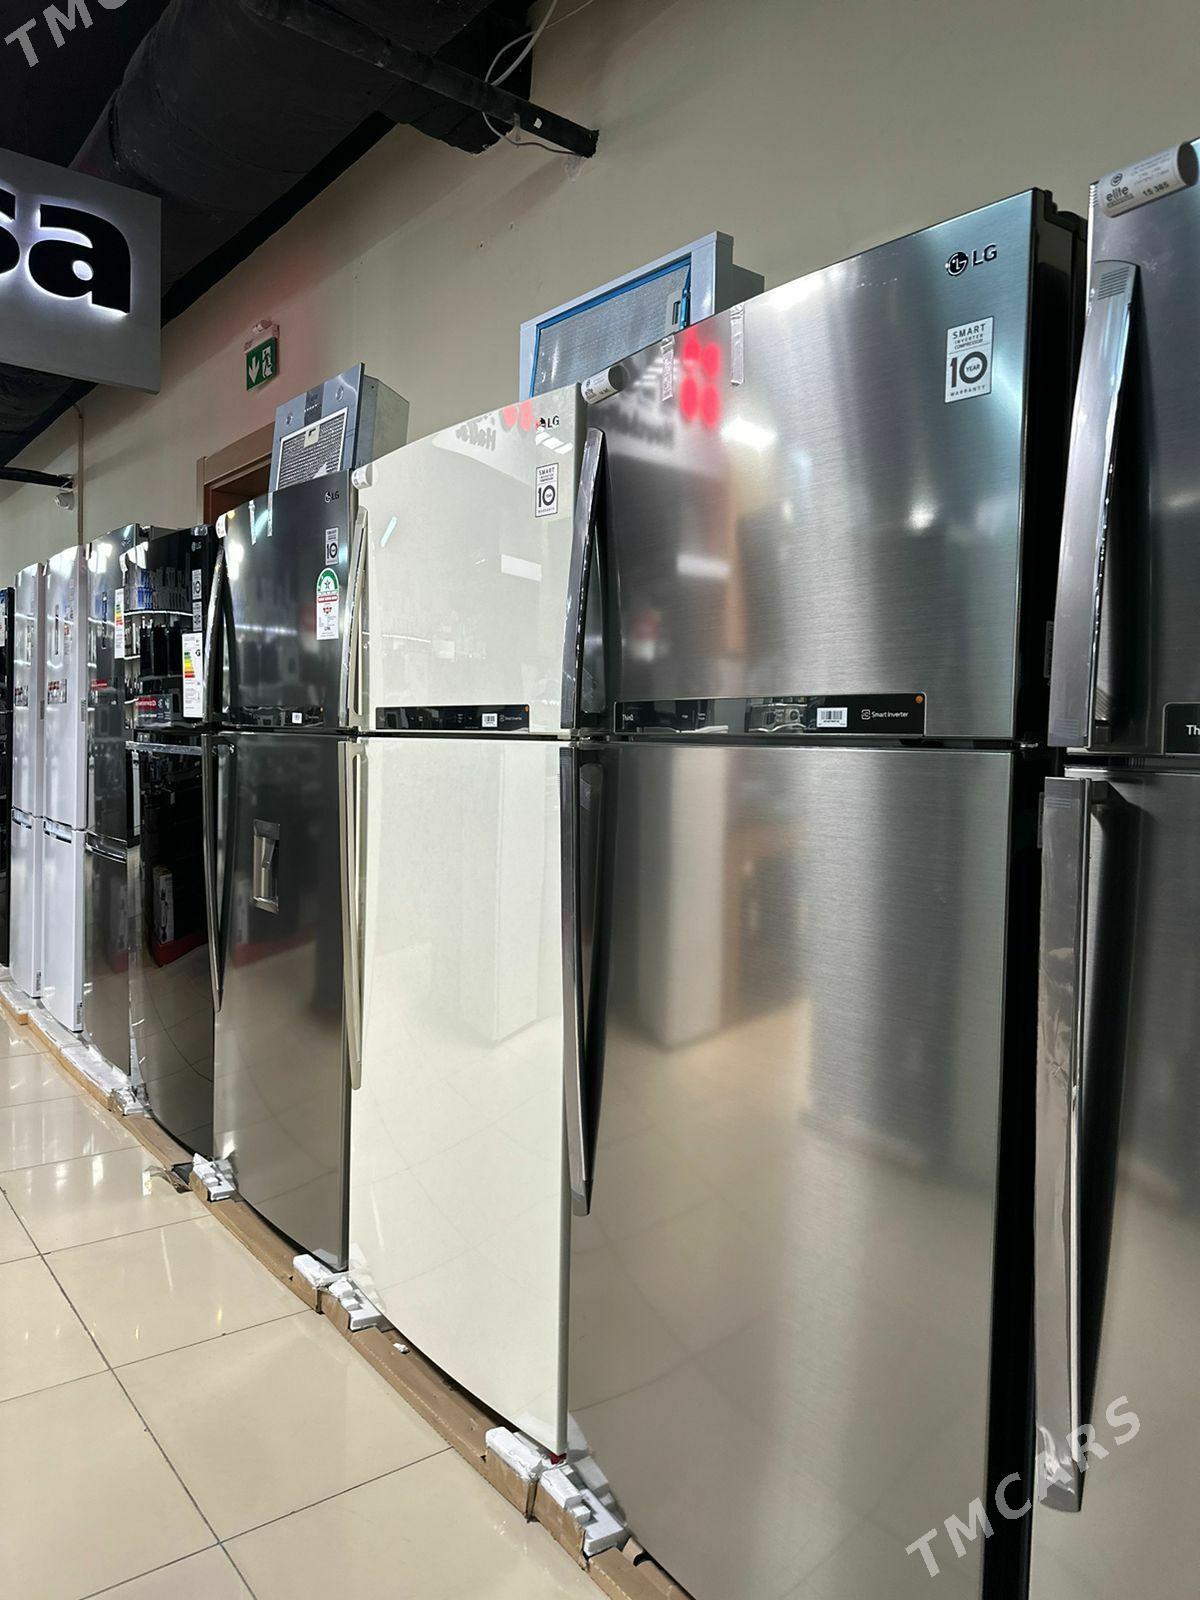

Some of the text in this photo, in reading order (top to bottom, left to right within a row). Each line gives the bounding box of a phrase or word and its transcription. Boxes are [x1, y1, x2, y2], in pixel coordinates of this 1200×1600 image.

[1106, 186, 1129, 202] elite
[0, 186, 131, 314] a
[972, 243, 998, 266] LG
[952, 323, 986, 340] SMART
[954, 333, 984, 344] INVERTER
[950, 351, 988, 388] 10
[965, 363, 981, 373] YEAR
[950, 384, 986, 397] WARRANTY
[547, 415, 560, 428] LG
[537, 484, 556, 508] 10
[1185, 724, 1200, 736] Th
